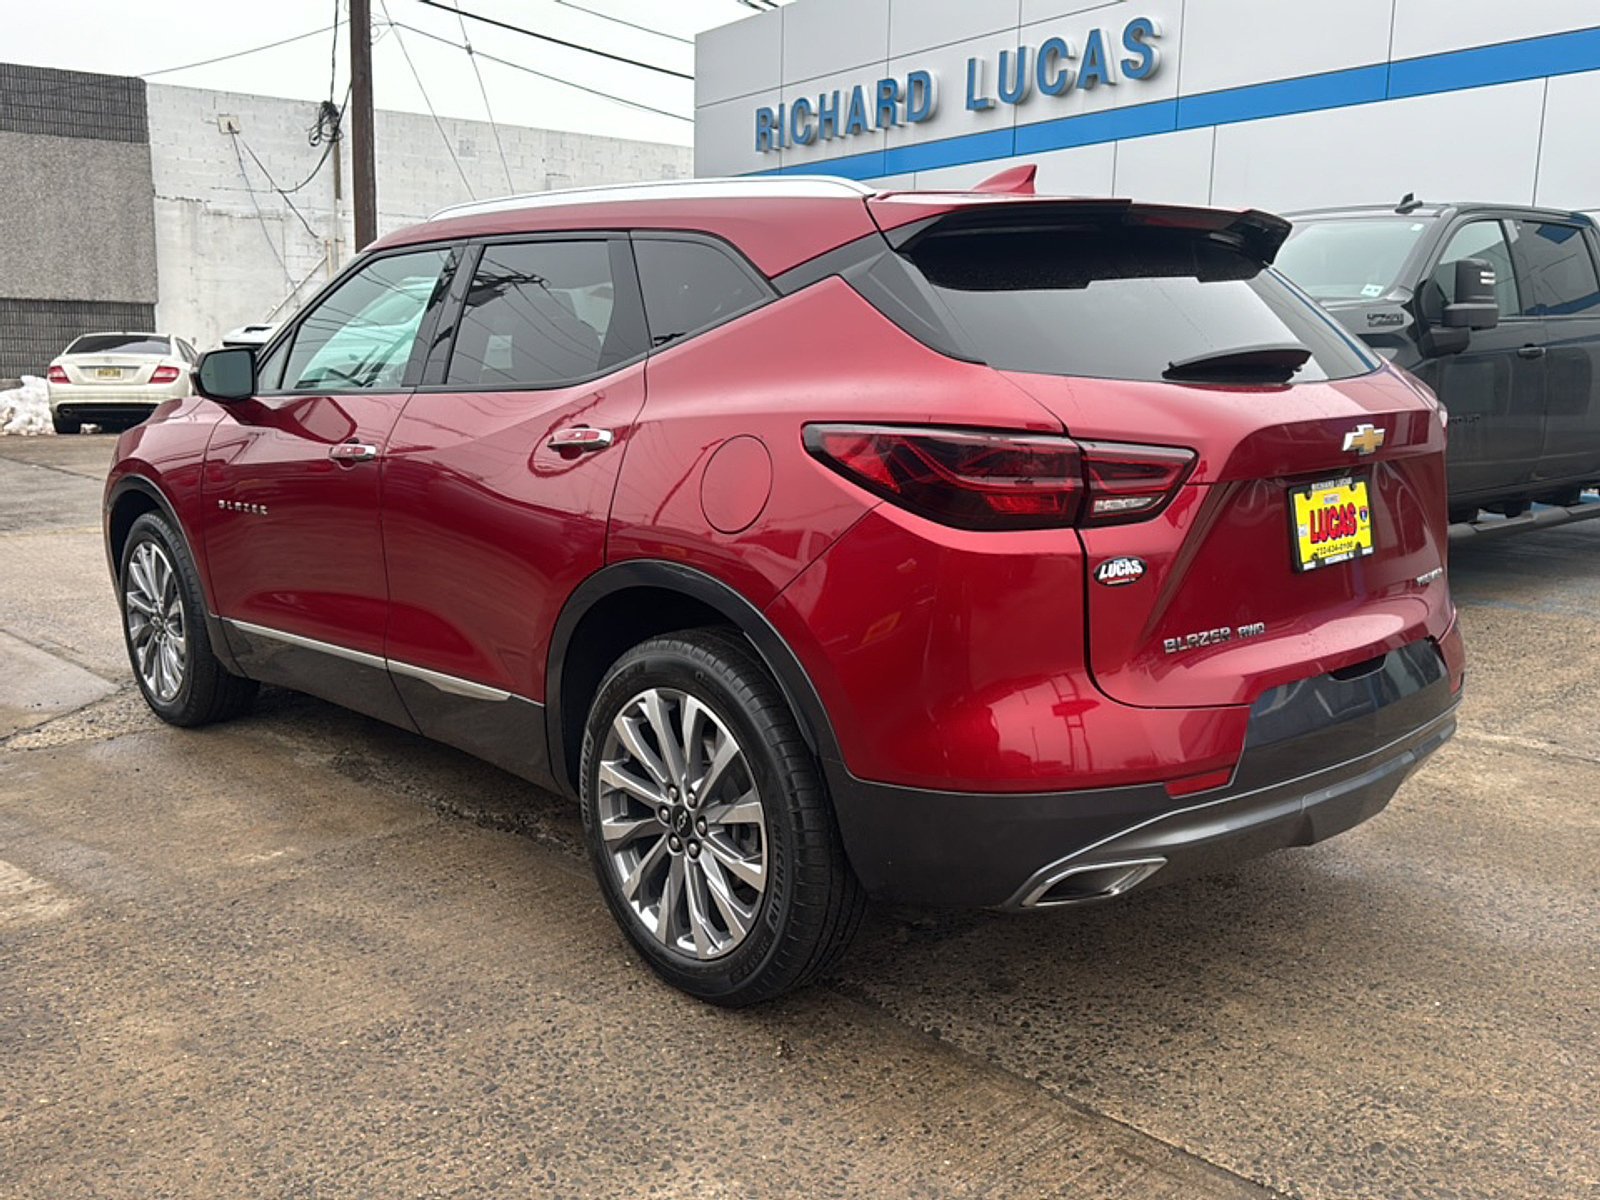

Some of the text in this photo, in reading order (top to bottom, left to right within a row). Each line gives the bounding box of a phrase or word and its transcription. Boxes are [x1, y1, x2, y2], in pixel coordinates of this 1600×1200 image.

[755, 16, 1161, 152] RICHARD LUCAS
[1310, 502, 1357, 544] LUCAS
[1098, 559, 1143, 580] LUCAS
[1164, 622, 1265, 653] BLAZER AWD
